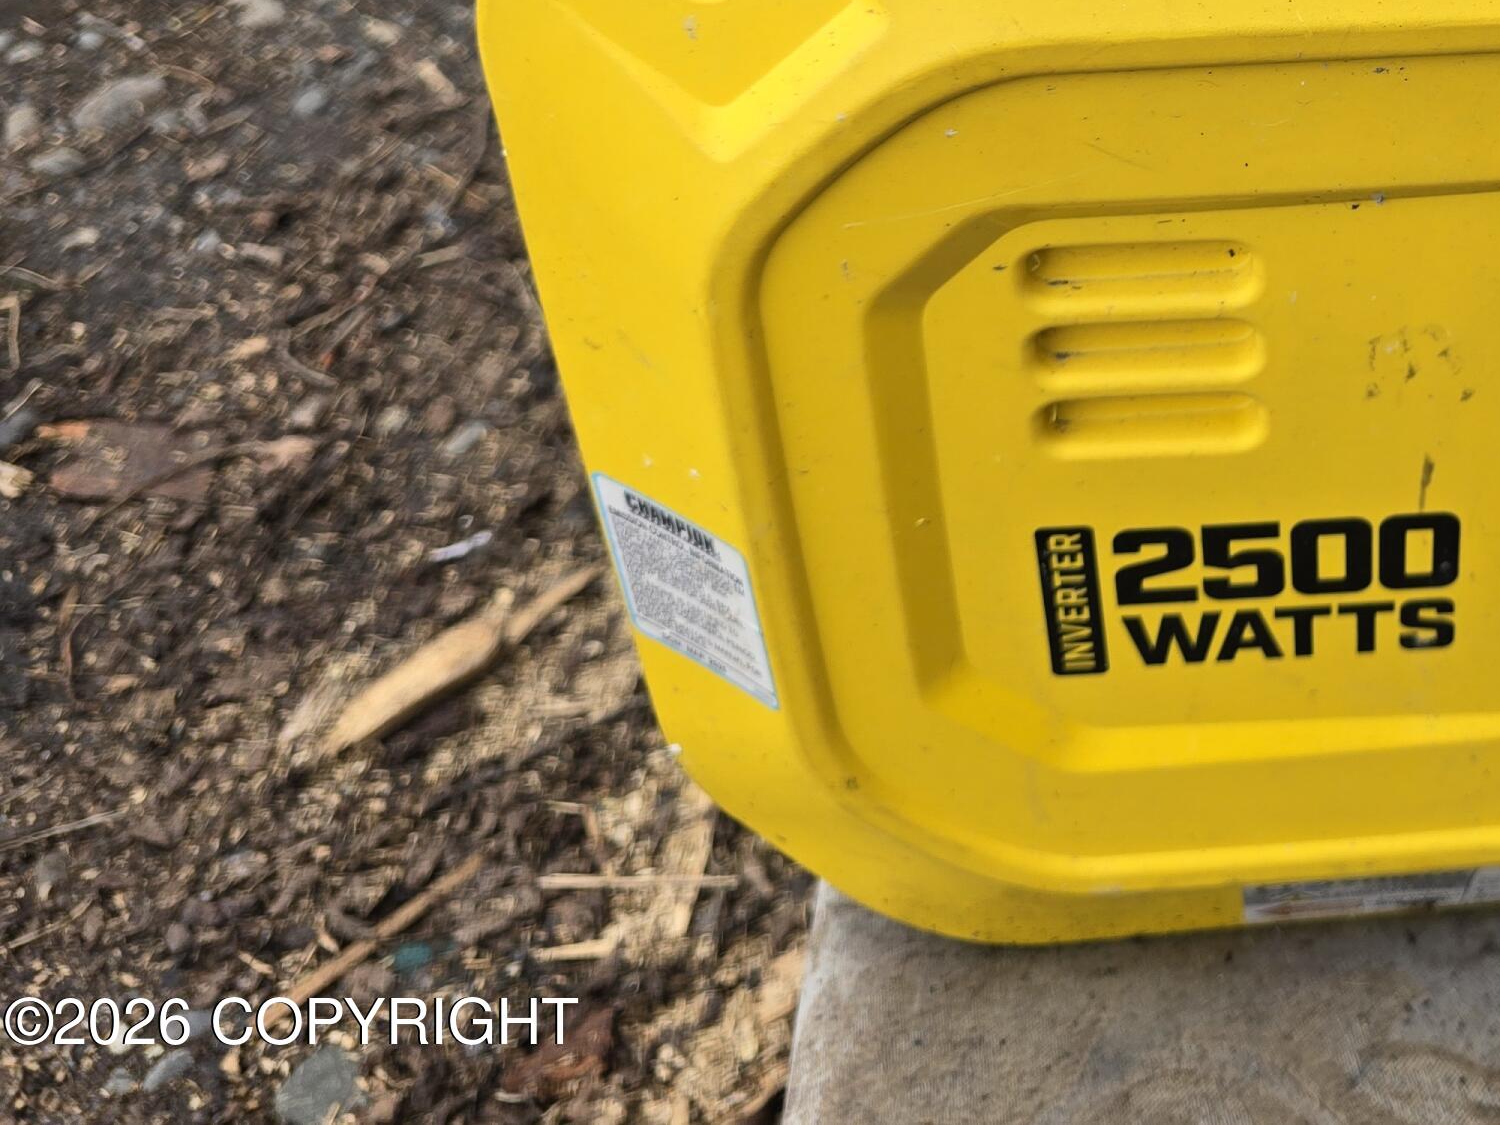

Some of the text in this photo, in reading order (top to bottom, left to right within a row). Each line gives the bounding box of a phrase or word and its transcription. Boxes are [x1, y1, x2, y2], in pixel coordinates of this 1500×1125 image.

[623, 489, 717, 555] CHAMPION
[1112, 512, 1462, 606] 2500
[1048, 531, 1096, 671] INVERTER
[1121, 597, 1456, 666] WATTS
